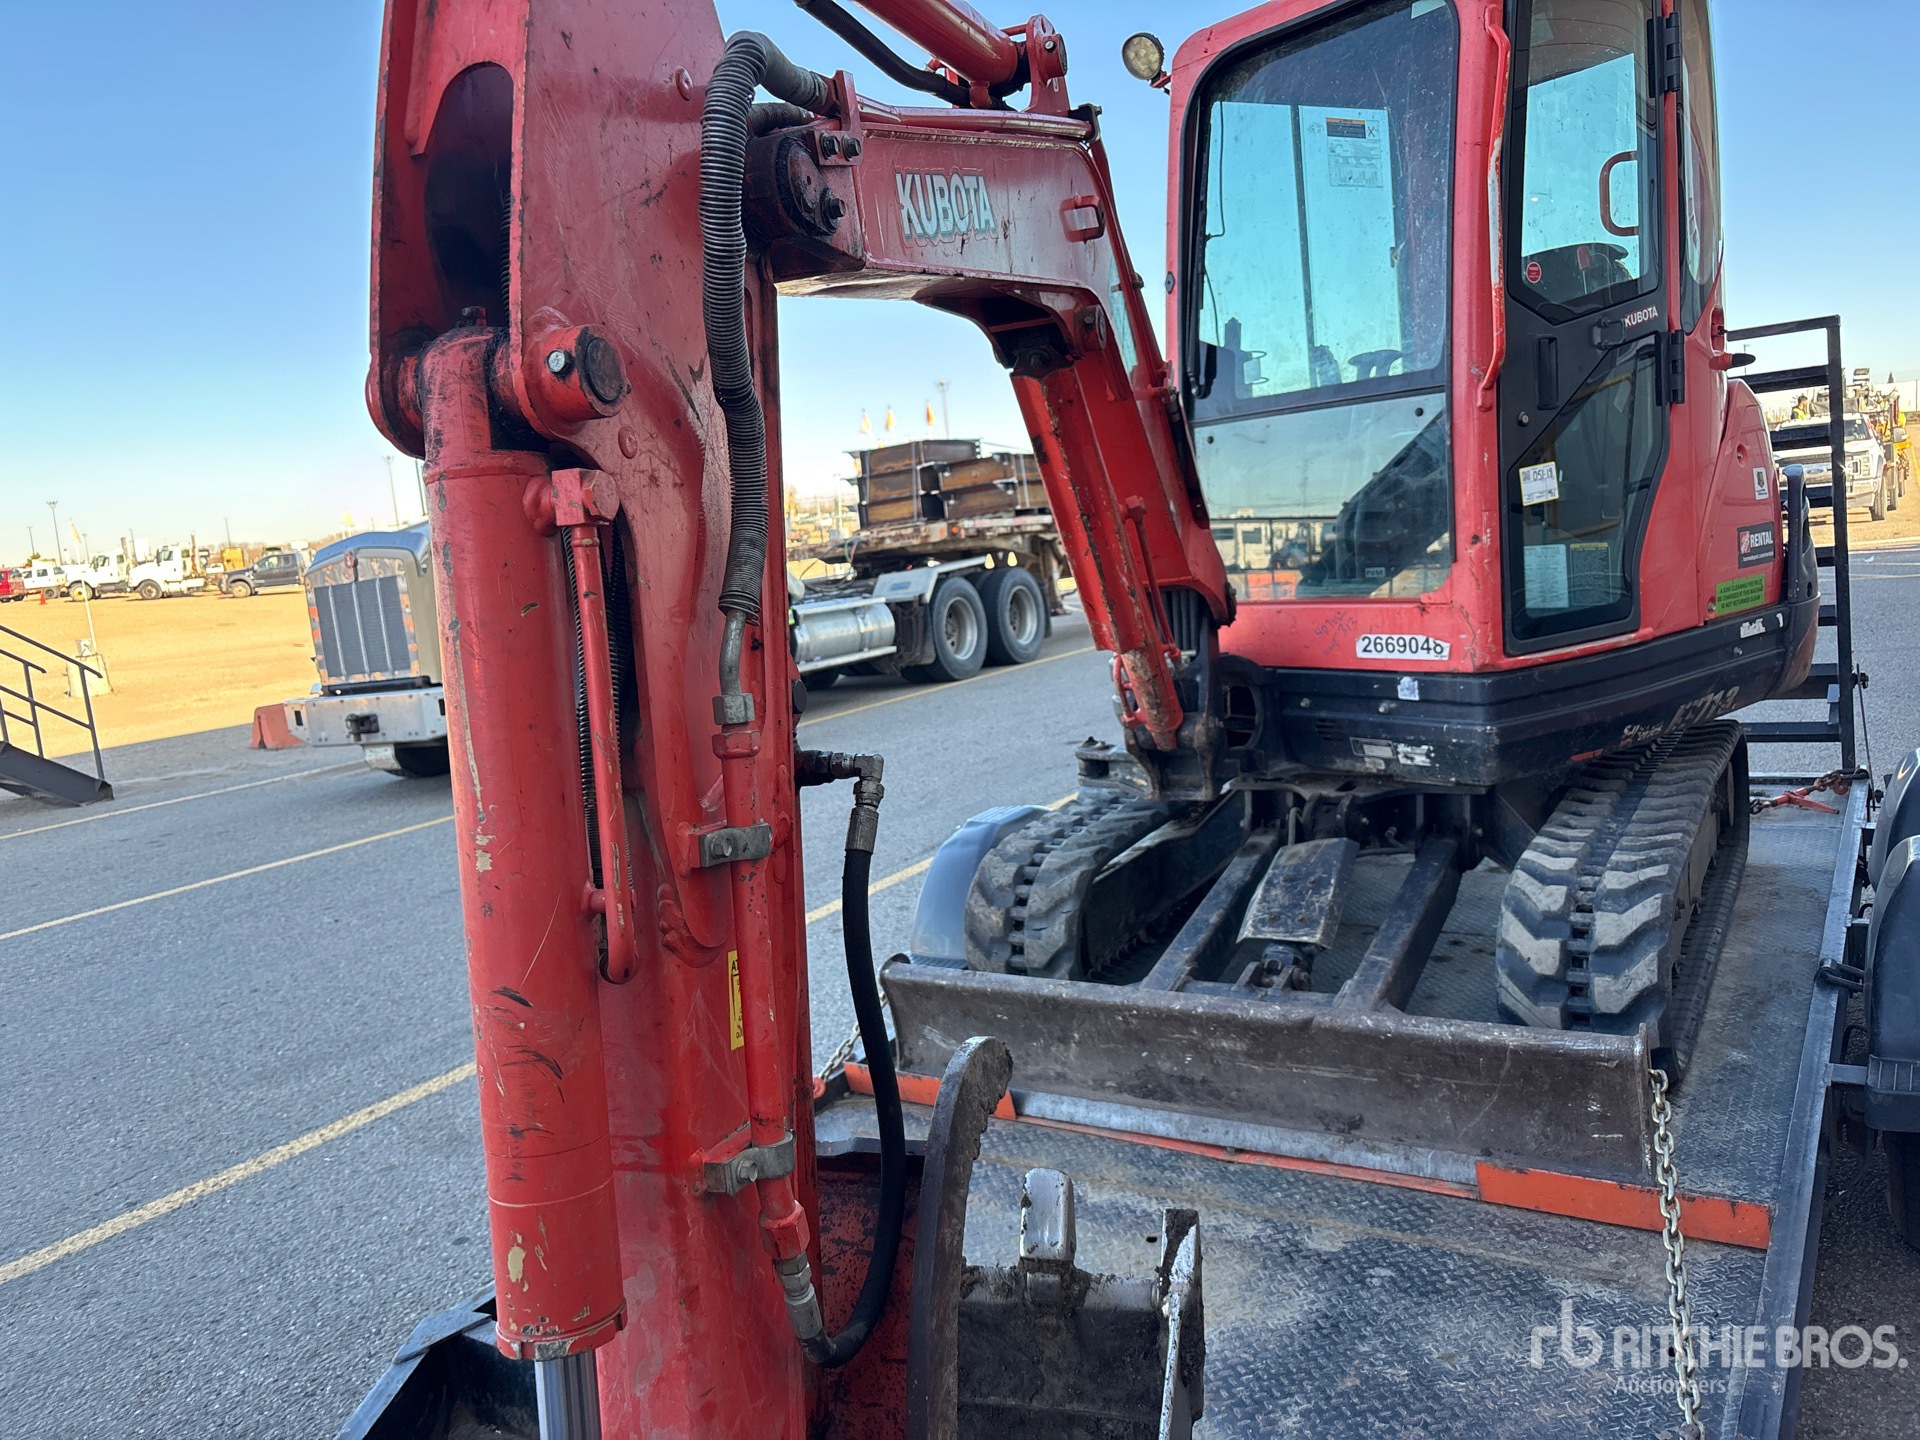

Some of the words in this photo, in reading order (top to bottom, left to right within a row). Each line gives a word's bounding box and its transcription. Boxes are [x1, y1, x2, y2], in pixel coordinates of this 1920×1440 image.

[895, 173, 996, 239] KUBOTA
[1624, 305, 1659, 328] KUBOTA
[1750, 531, 1773, 547] RENTAL
